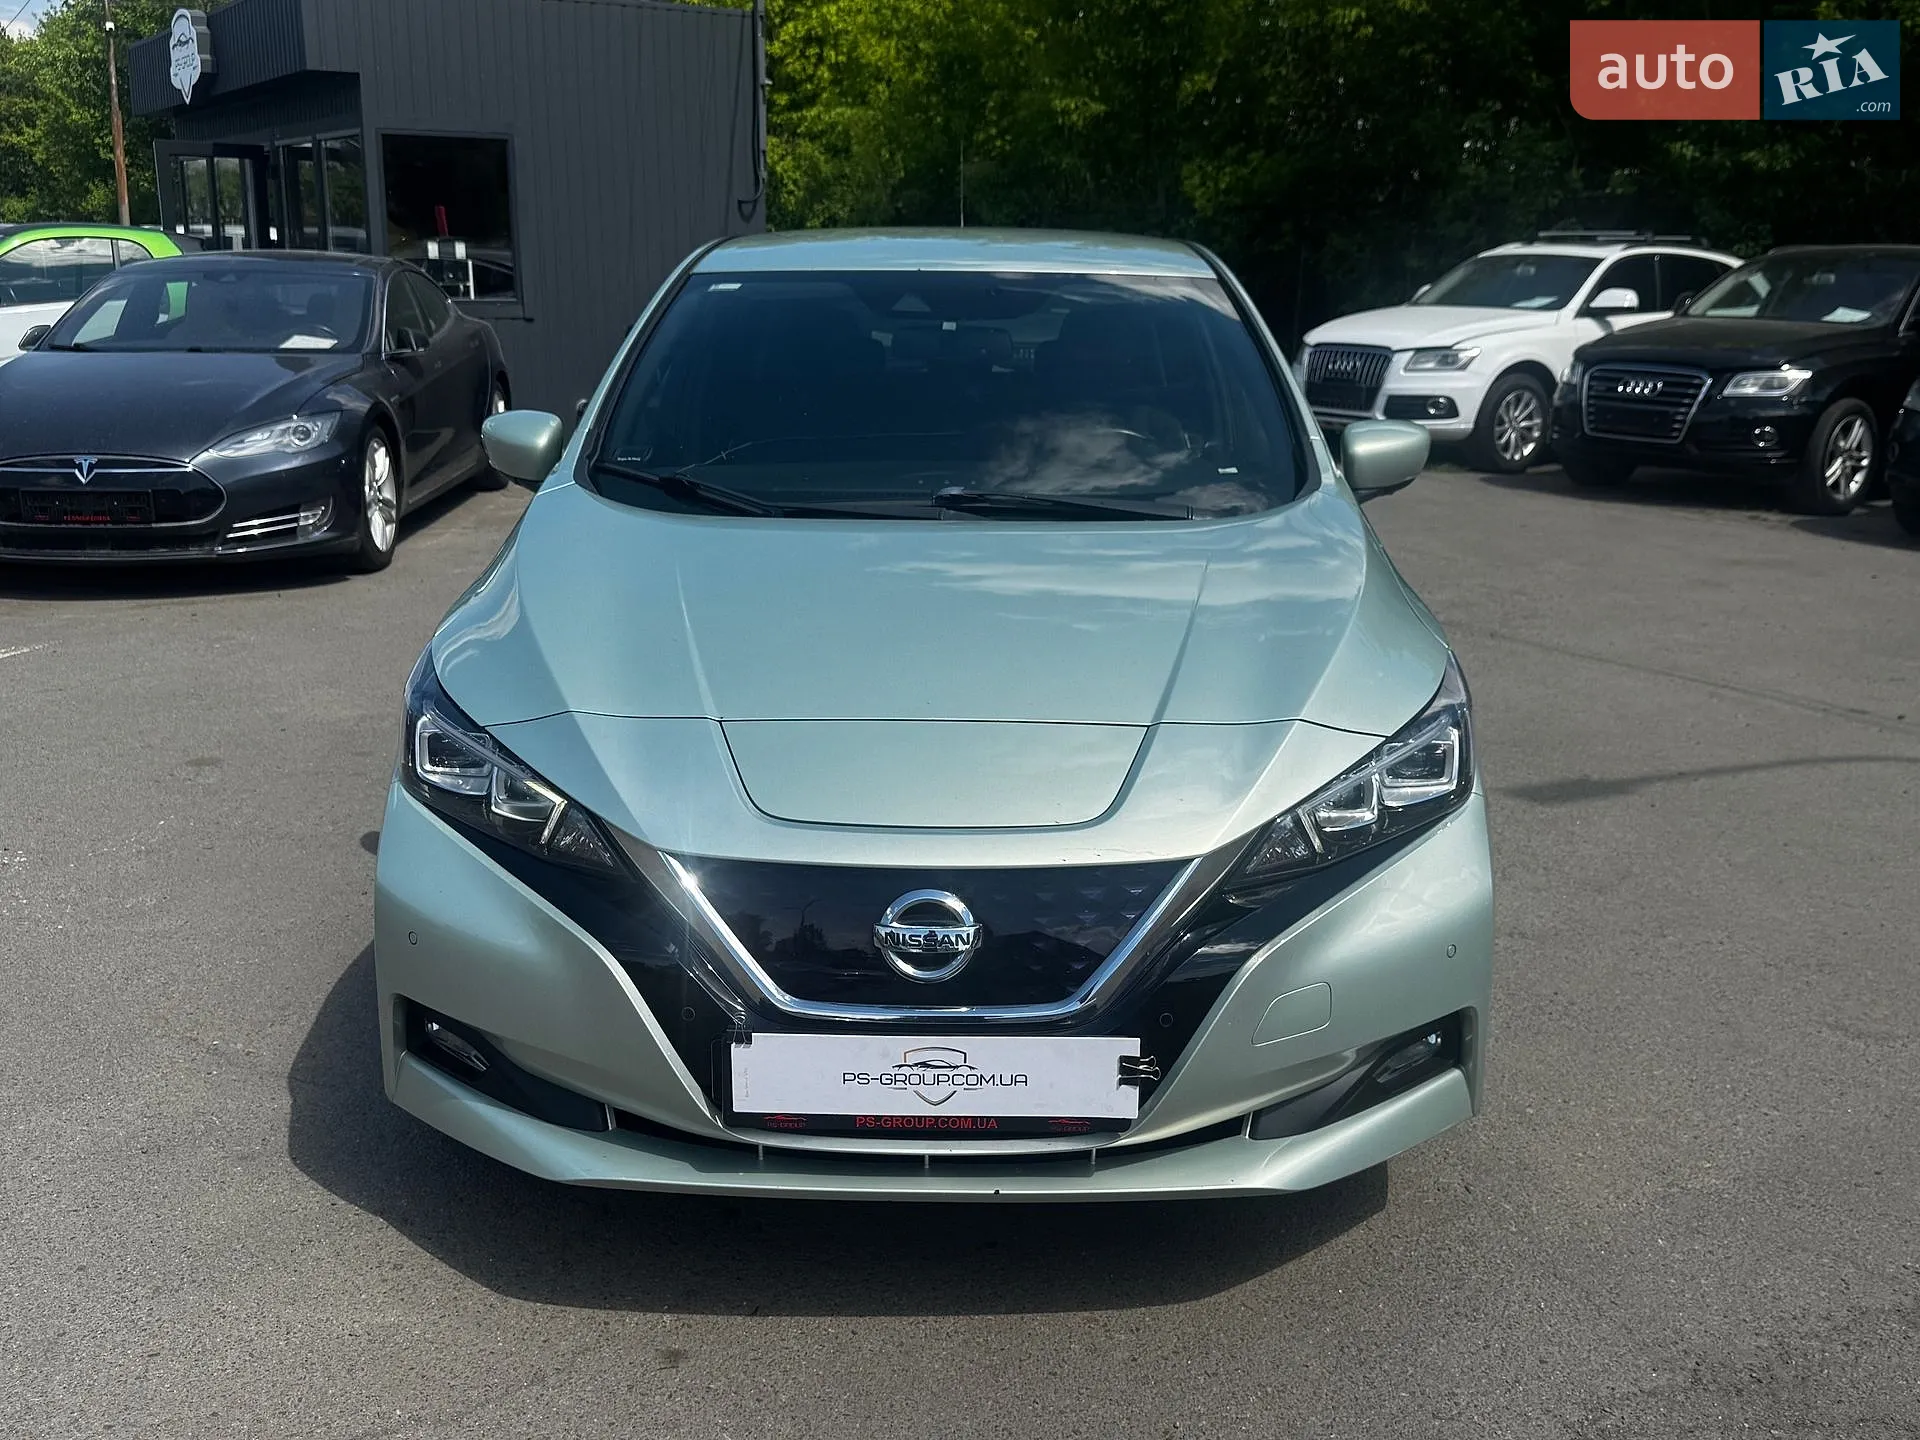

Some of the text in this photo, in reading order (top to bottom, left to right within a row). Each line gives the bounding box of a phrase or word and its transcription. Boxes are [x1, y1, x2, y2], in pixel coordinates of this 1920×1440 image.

[884, 931, 971, 949] NISSAN
[842, 1072, 1028, 1087] PS-GROUP.COM.UA
[855, 1116, 998, 1129] PS-GROUP.COM.UA
